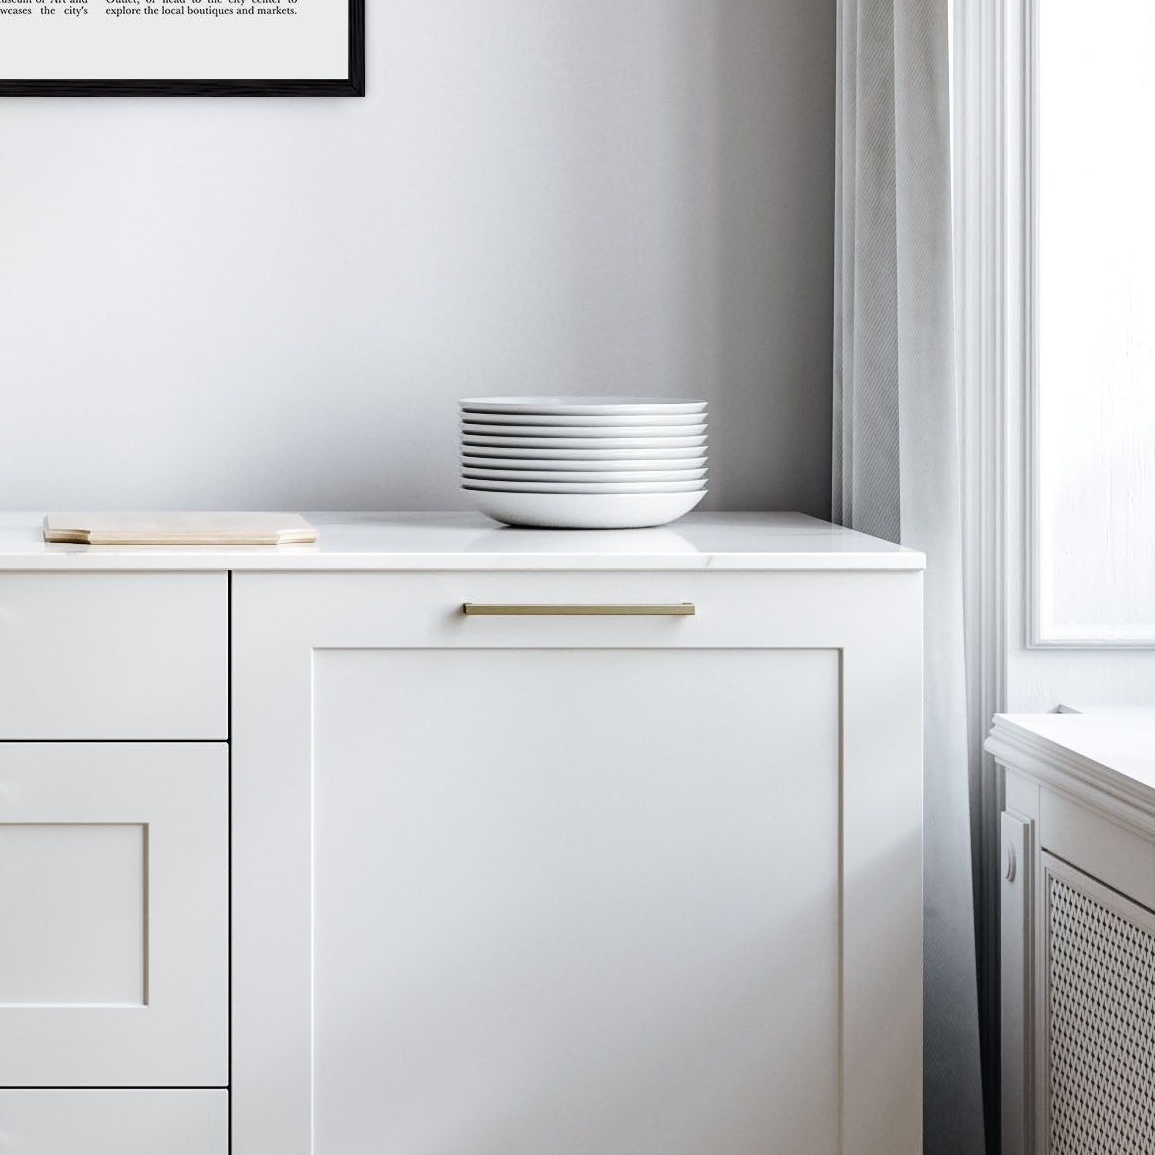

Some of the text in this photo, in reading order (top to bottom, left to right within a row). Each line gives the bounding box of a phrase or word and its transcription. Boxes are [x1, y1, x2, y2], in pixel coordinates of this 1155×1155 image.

[40, 6, 55, 14] the
[63, 6, 88, 17] city's
[105, 6, 296, 17] explore the local boutiques and markets.
